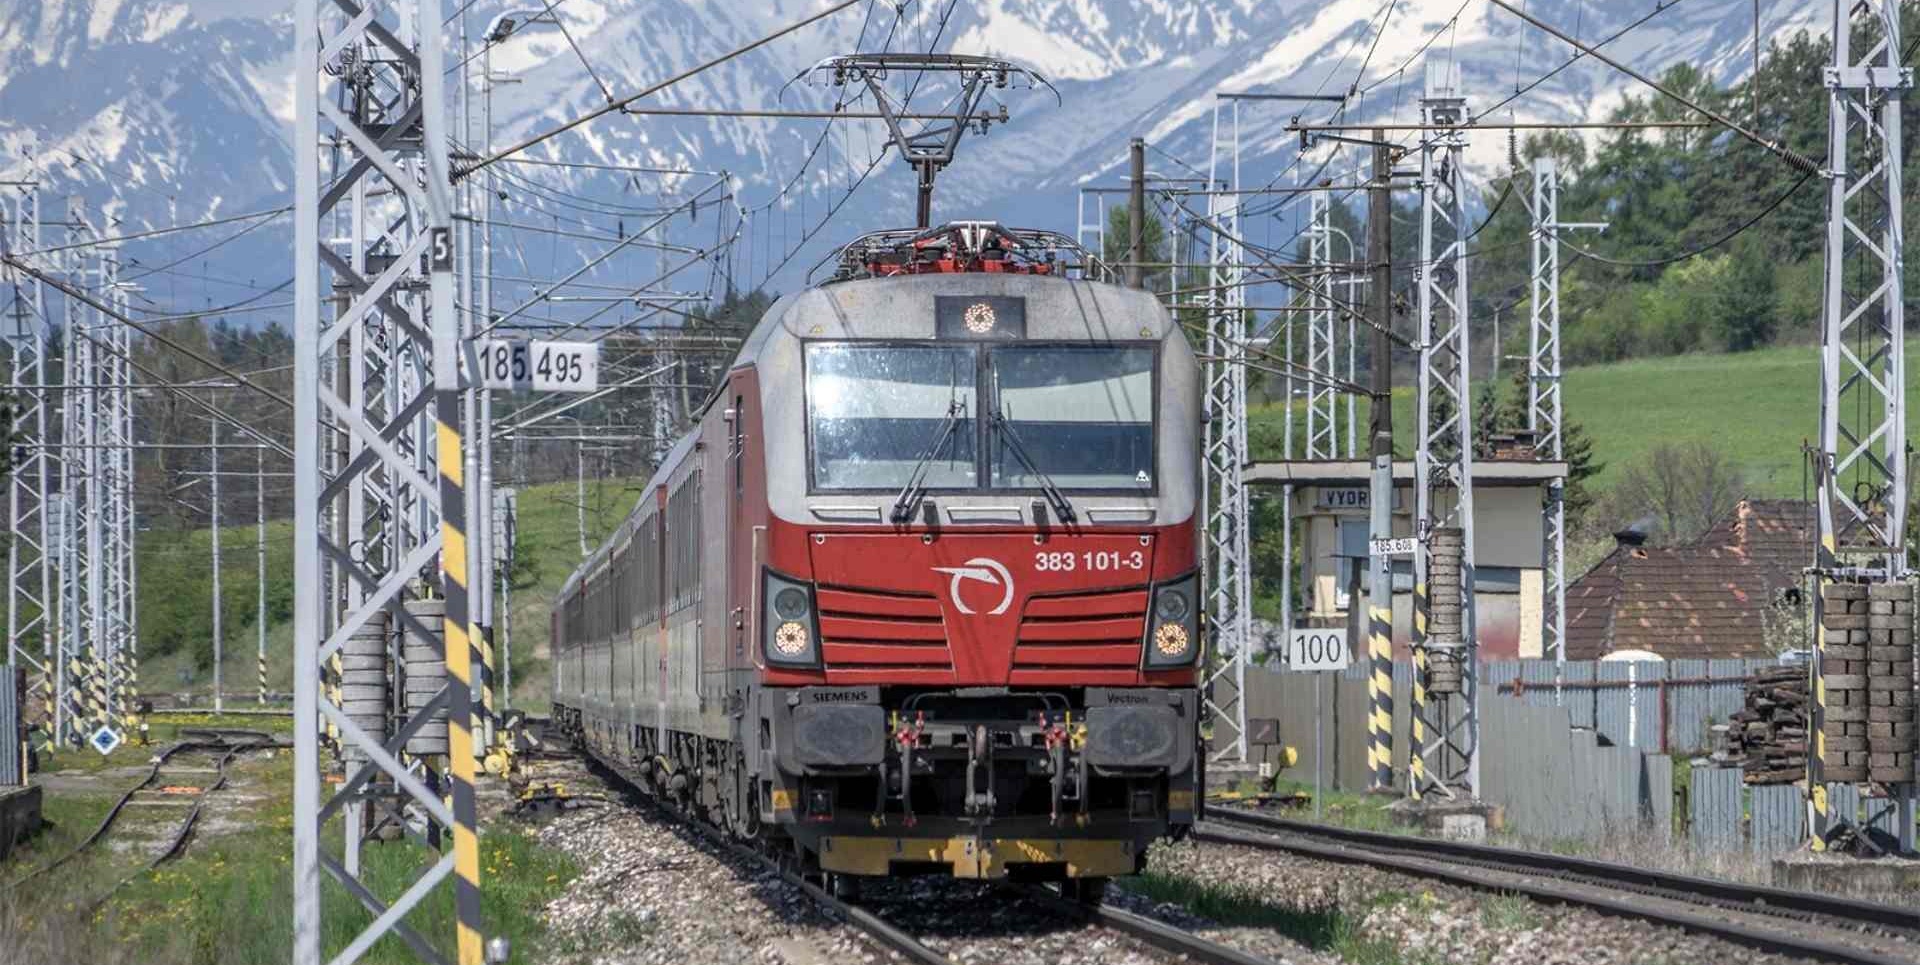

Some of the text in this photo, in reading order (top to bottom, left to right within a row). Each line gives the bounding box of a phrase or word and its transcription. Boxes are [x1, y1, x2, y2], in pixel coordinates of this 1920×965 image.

[434, 232, 448, 261] 5
[480, 346, 582, 383] 185.495
[1327, 490, 1368, 505] VYDR
[1035, 550, 1143, 571] 383 101-3
[1296, 634, 1341, 664] 100
[813, 691, 868, 703] SIEMENS
[1107, 690, 1149, 703] Vectron
